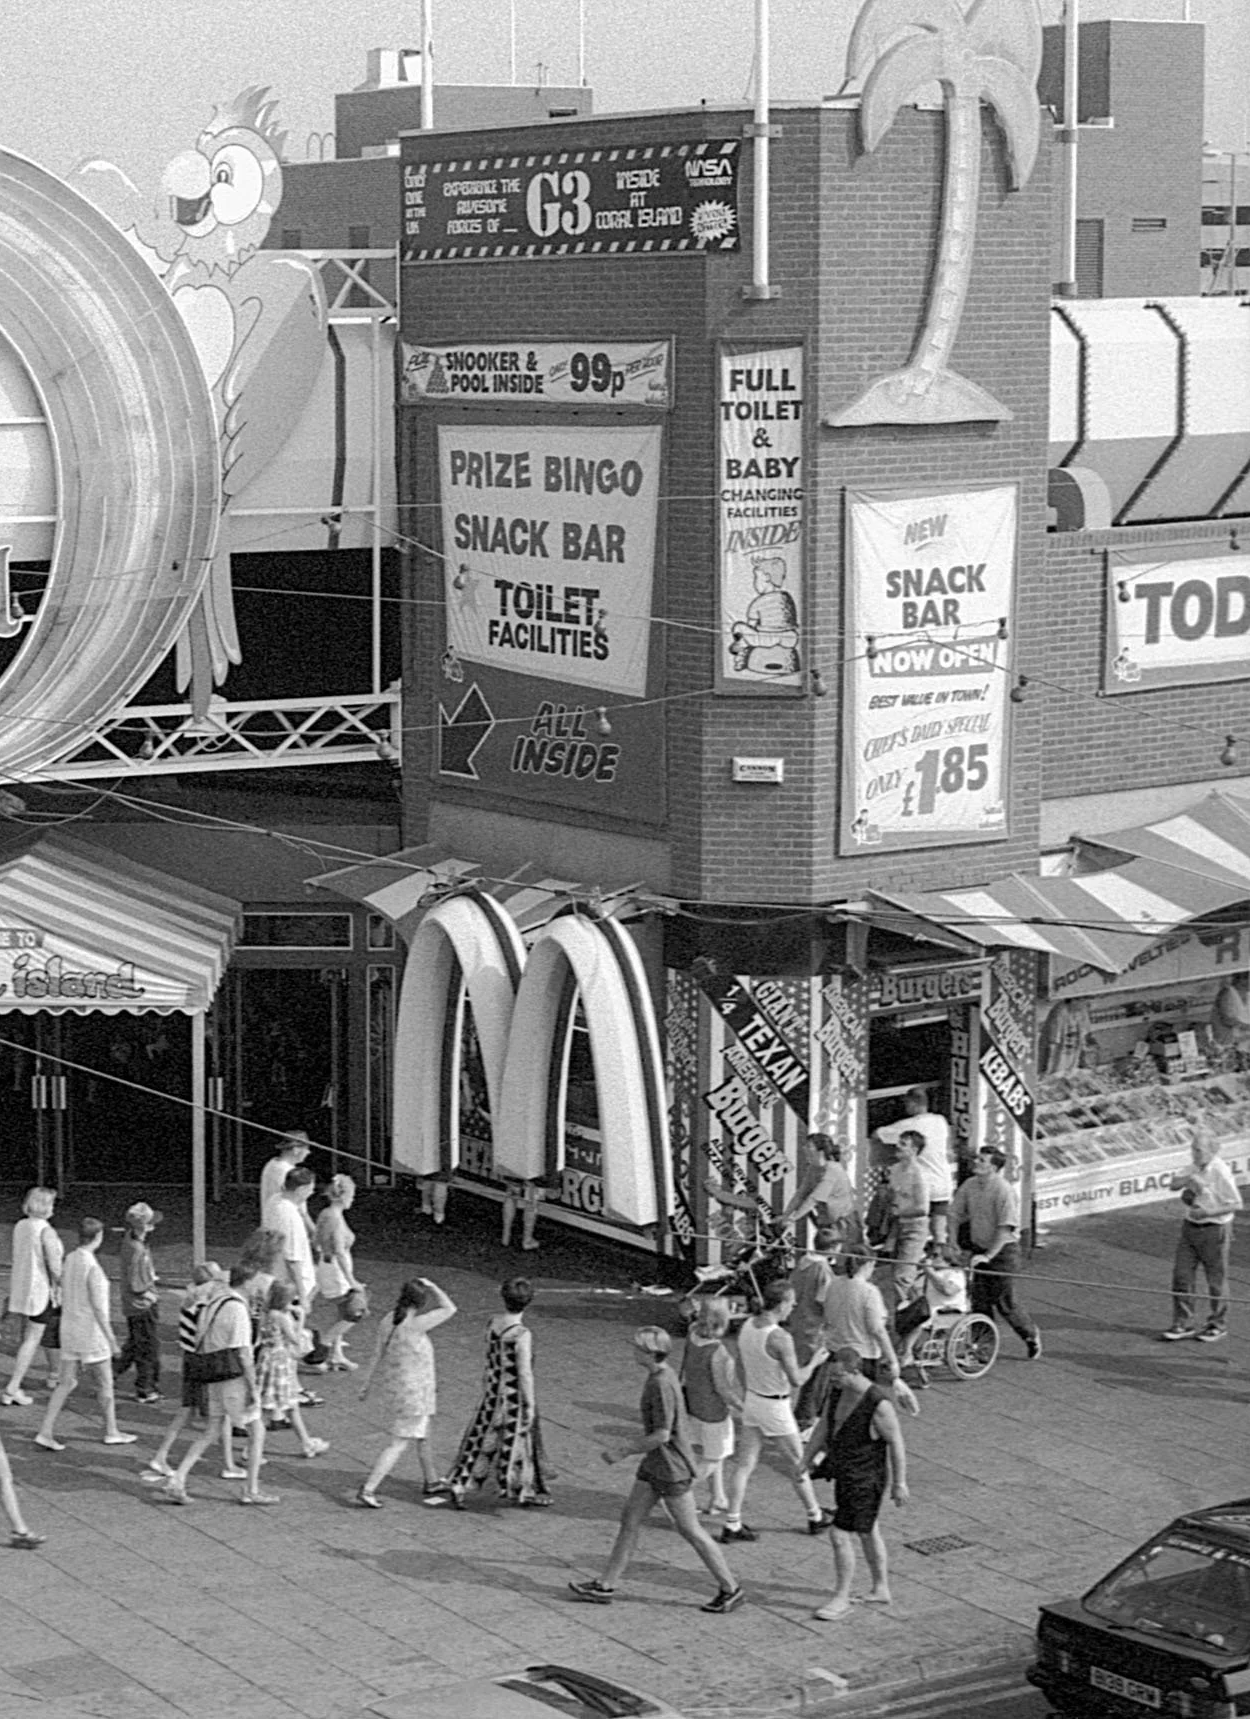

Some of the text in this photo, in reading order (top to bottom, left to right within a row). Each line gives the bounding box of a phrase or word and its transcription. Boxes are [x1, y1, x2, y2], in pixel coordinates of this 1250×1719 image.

[616, 168, 660, 190] INSIDE
[685, 159, 732, 177] NASA
[443, 178, 521, 197] EXPERIENCE THE
[526, 170, 591, 237] G3
[630, 191, 647, 207] AT
[456, 198, 507, 215] AWESOME
[595, 209, 634, 230] CORAL
[638, 206, 682, 227] ISLAND
[447, 218, 501, 235] FORCES OF
[445, 351, 520, 371] SNOOKER
[526, 351, 538, 371] &
[570, 352, 625, 398] 99p
[451, 374, 544, 393] POOL INSIDE
[729, 368, 796, 393] FULL
[721, 401, 801, 421] TOILET
[752, 427, 773, 449] &
[450, 450, 643, 497] PRIZE BINGO
[725, 456, 800, 480] BABY
[721, 487, 805, 502] CHANGING
[727, 506, 798, 519] FACILITIES
[454, 513, 626, 564] SNACK BAR
[727, 520, 801, 552] INSIDE
[903, 514, 948, 546] NEW
[886, 563, 987, 599] SNACK
[494, 579, 600, 626] TOILET
[902, 599, 961, 629] BAR
[489, 620, 610, 661] FACILITIES
[873, 642, 995, 674] NOW OPEN
[868, 683, 990, 710] BEST VALUE IN TOWN!
[531, 700, 588, 740] ALL
[910, 720, 942, 743] DAILY
[944, 713, 992, 735] SPECIAL
[510, 735, 621, 783] INSIDE
[866, 769, 901, 800] ONLY
[18, 930, 35, 947] TO
[12, 953, 146, 1000] island
[879, 972, 974, 1007] Burgers
[755, 980, 805, 1040] GIANT
[818, 983, 867, 1041] AMERICAN
[985, 987, 1031, 1060] Burgers
[738, 1011, 808, 1094] TEXAN
[814, 1010, 864, 1086] Burgers
[720, 1043, 779, 1110] AMERICAN
[979, 1045, 1031, 1117] KEBABS
[703, 1075, 794, 1182] Burgers
[1038, 1195, 1059, 1210] EST
[1062, 1187, 1114, 1206] QUALITY
